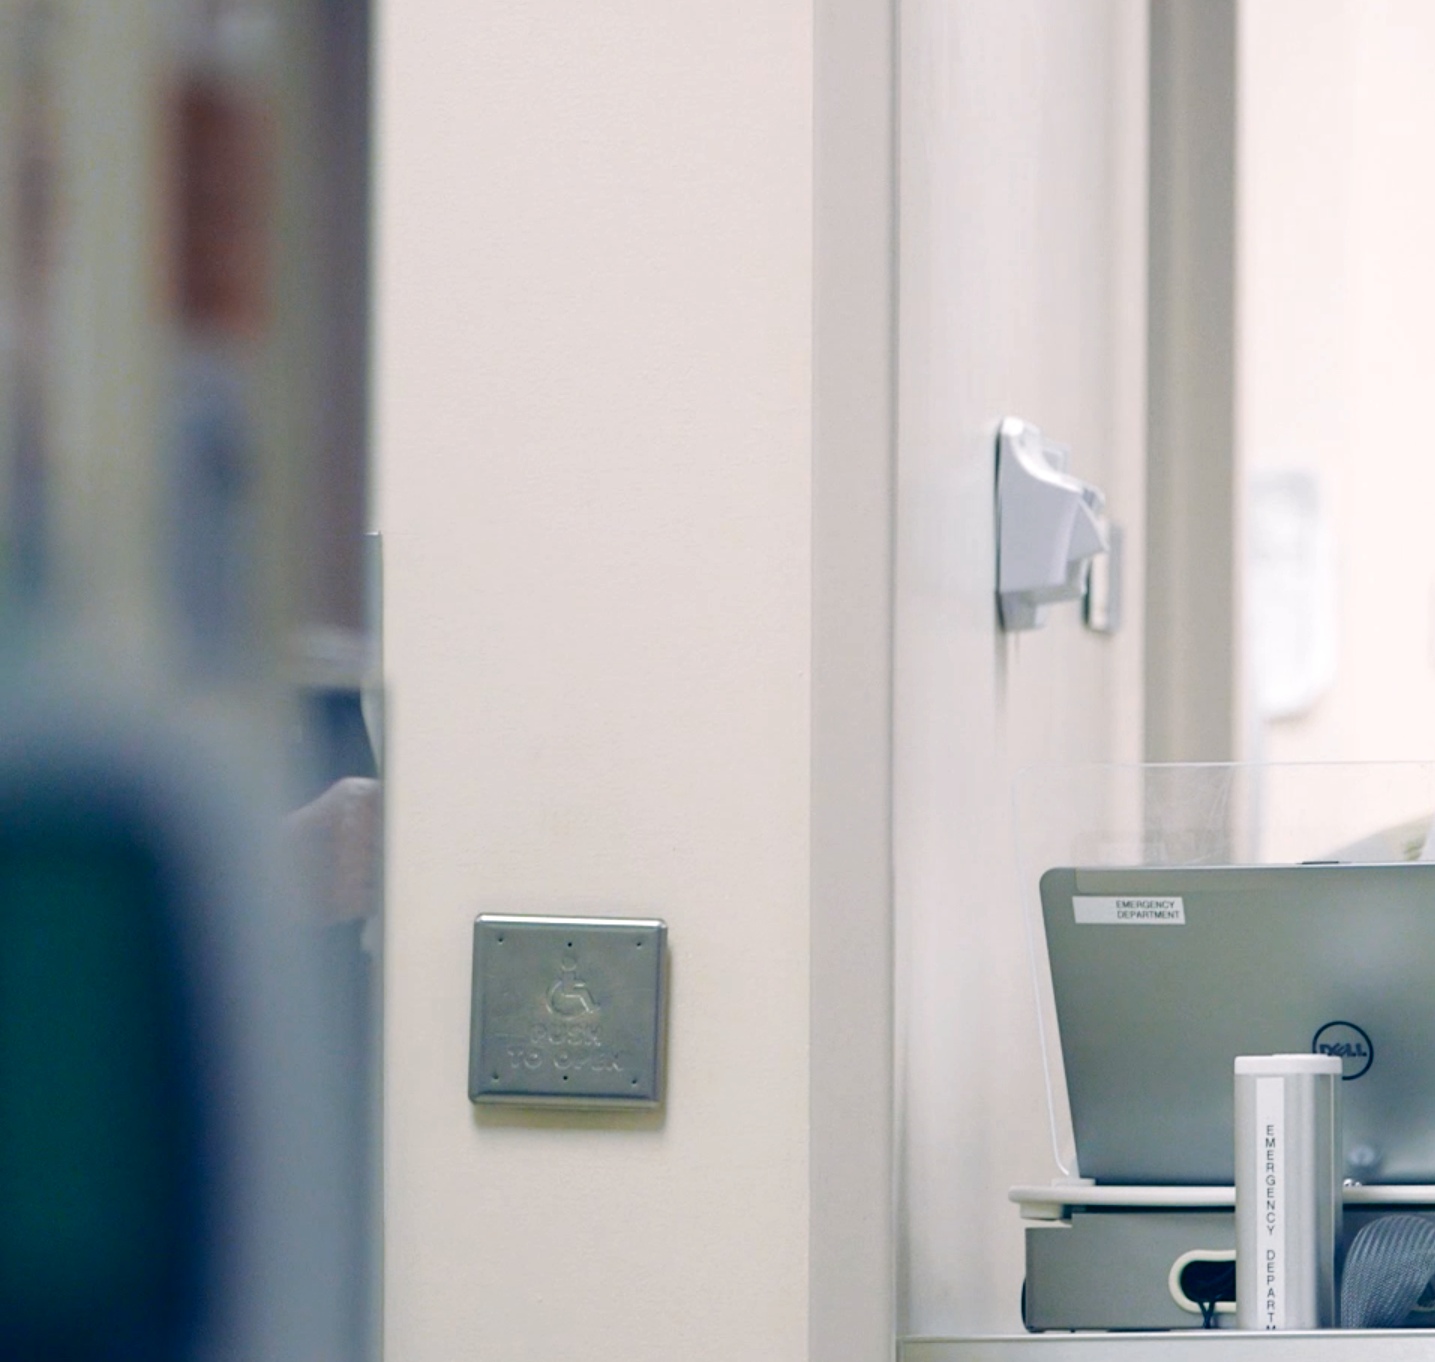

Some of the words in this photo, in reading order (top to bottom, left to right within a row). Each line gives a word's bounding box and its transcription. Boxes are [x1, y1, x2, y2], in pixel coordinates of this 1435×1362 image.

[1116, 901, 1175, 909] EMERGENCY
[1117, 910, 1180, 919] DEPARTMENT
[530, 1023, 602, 1047] PUSH
[1319, 1042, 1367, 1057] DELL
[506, 1047, 543, 1069] TO
[552, 1048, 624, 1072] OPEN
[1265, 1124, 1276, 1236] EMERGENCY
